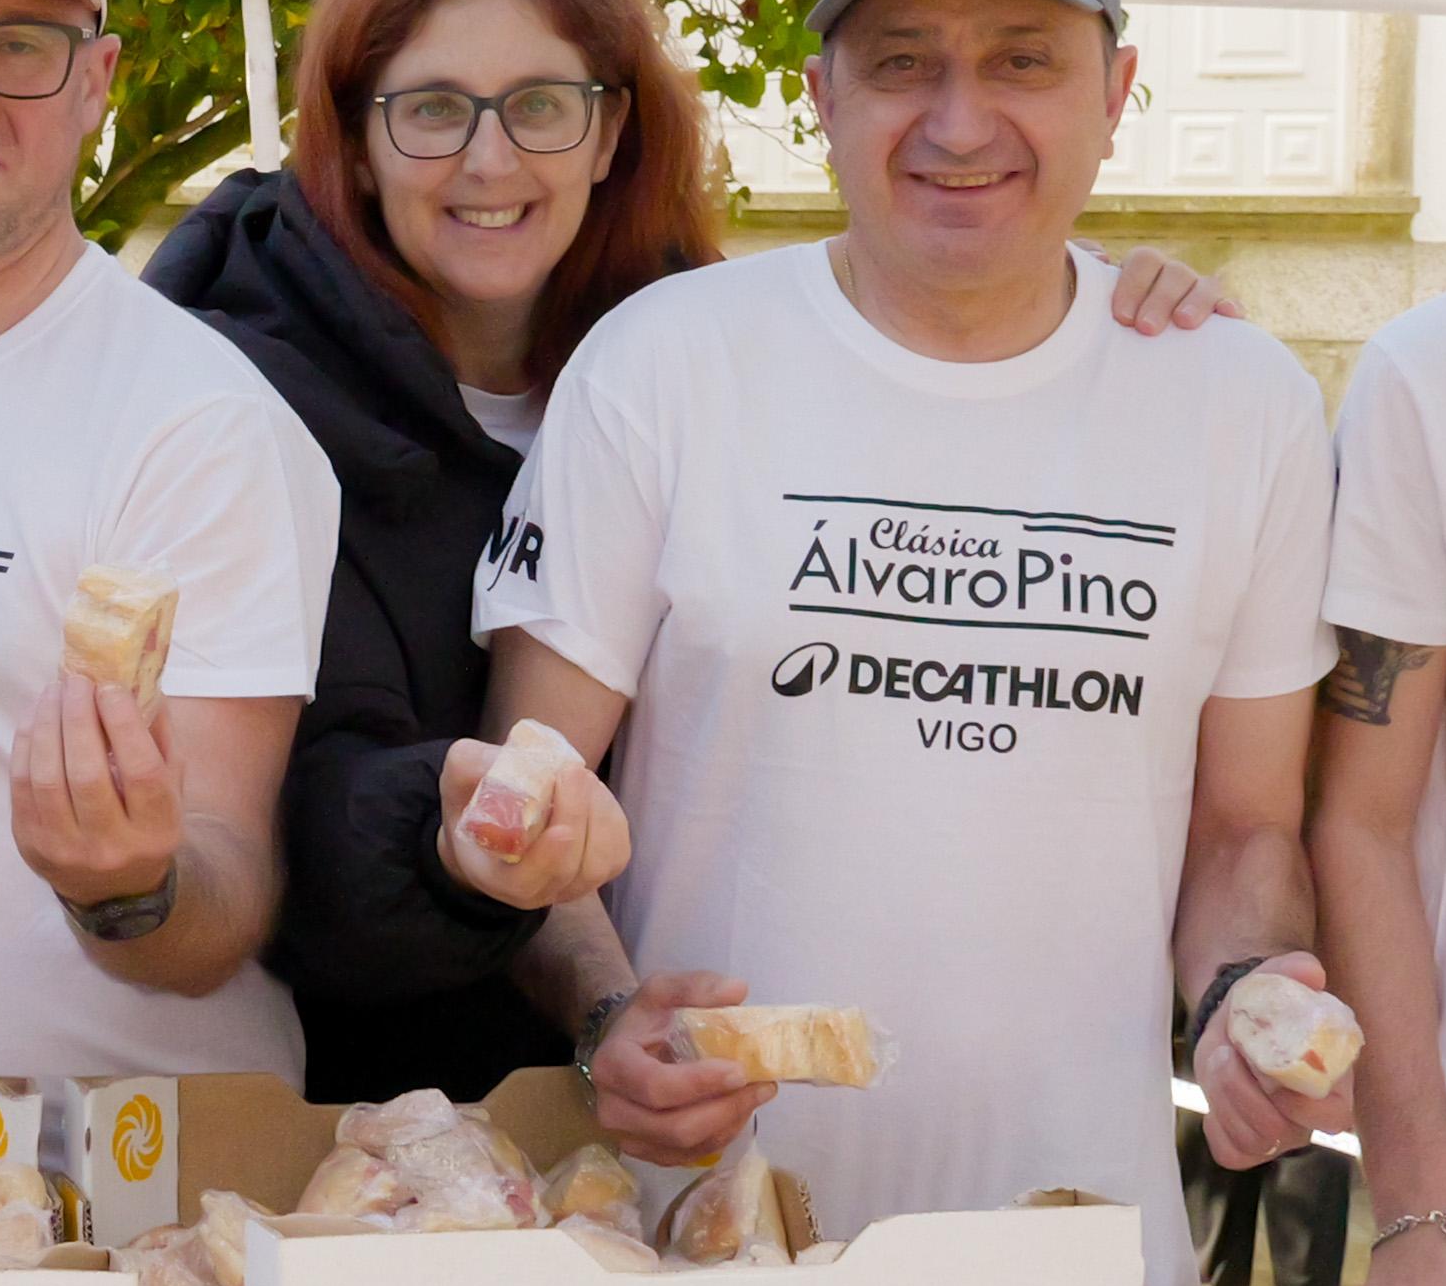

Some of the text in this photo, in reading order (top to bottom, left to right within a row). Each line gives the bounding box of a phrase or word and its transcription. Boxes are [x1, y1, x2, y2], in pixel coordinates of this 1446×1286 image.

[869, 517, 1003, 560] Clásica
[849, 653, 1144, 717] DECATHLON
[917, 717, 1018, 755] VIGO
